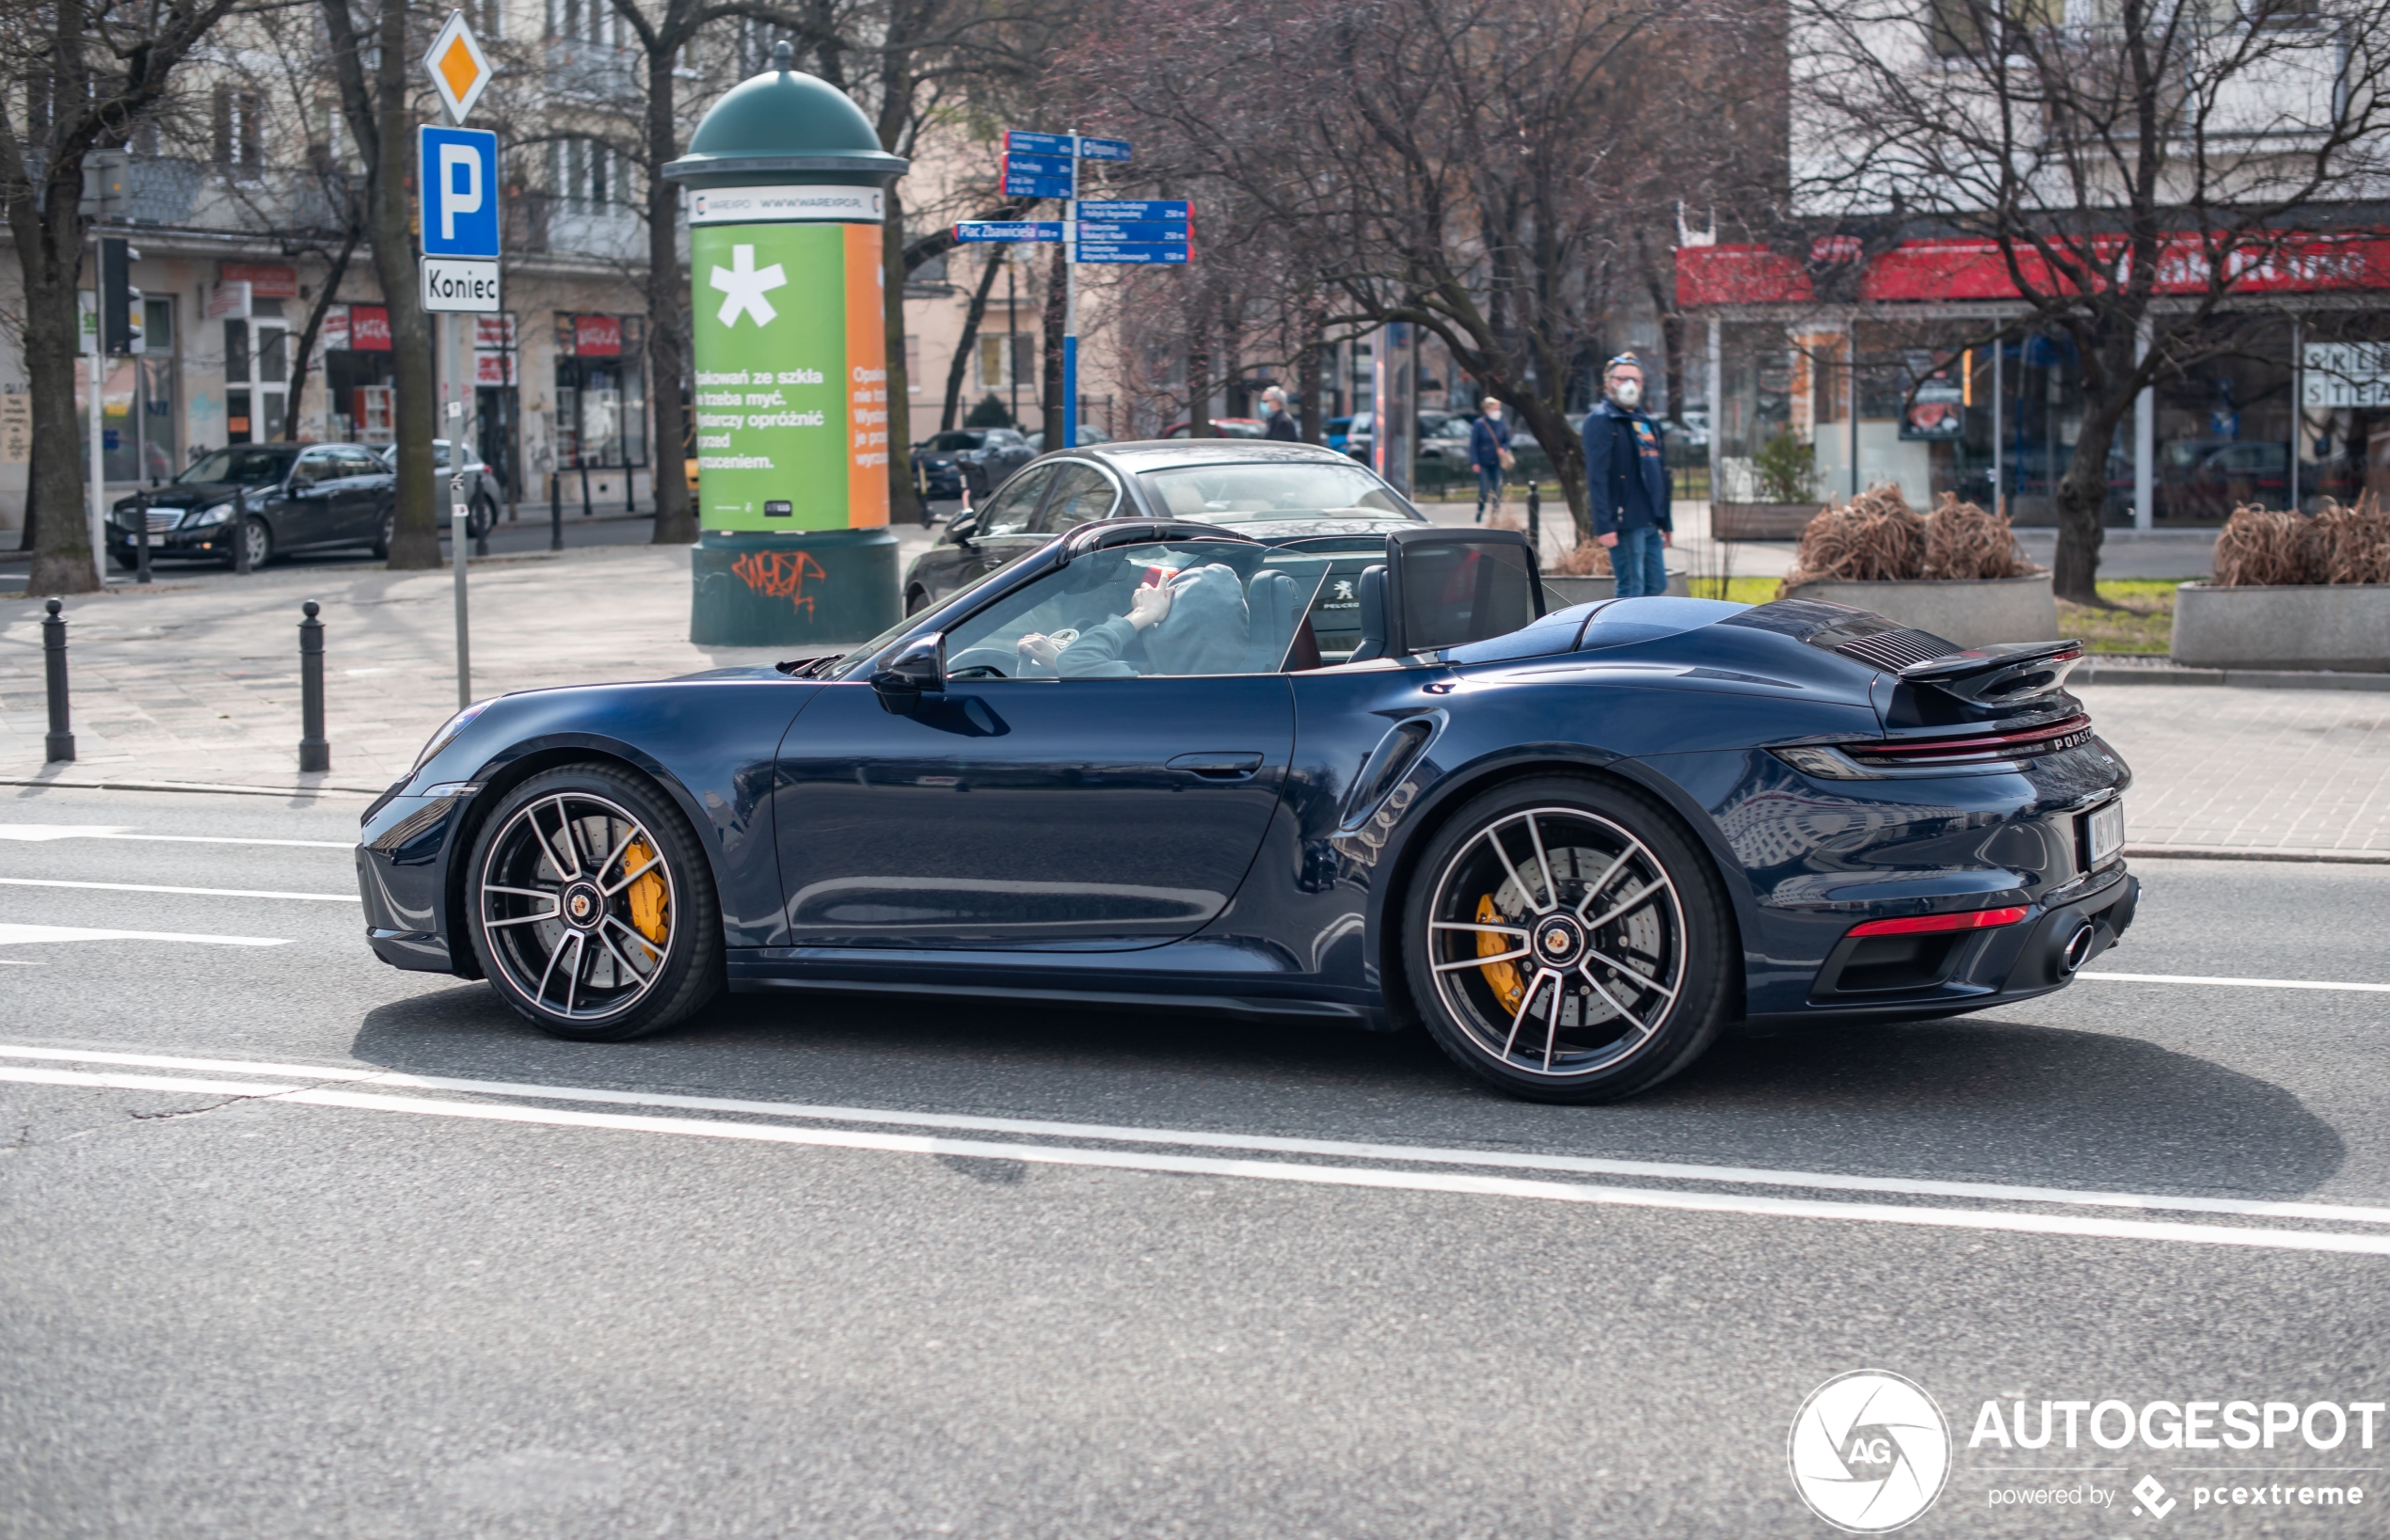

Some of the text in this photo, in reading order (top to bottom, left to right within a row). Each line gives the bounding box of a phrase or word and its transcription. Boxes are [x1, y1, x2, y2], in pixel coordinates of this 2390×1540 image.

[439, 143, 483, 240] P
[959, 225, 980, 237] Plac
[981, 225, 1036, 237] Zbawiciela
[428, 269, 496, 299] Koniec
[694, 369, 749, 386] pakowań
[752, 372, 773, 385] ze
[745, 389, 788, 409] myć.
[852, 388, 871, 403] nie
[747, 409, 825, 430] opróżnić
[853, 429, 867, 449] je
[640, 877, 650, 918] ORSCHE
